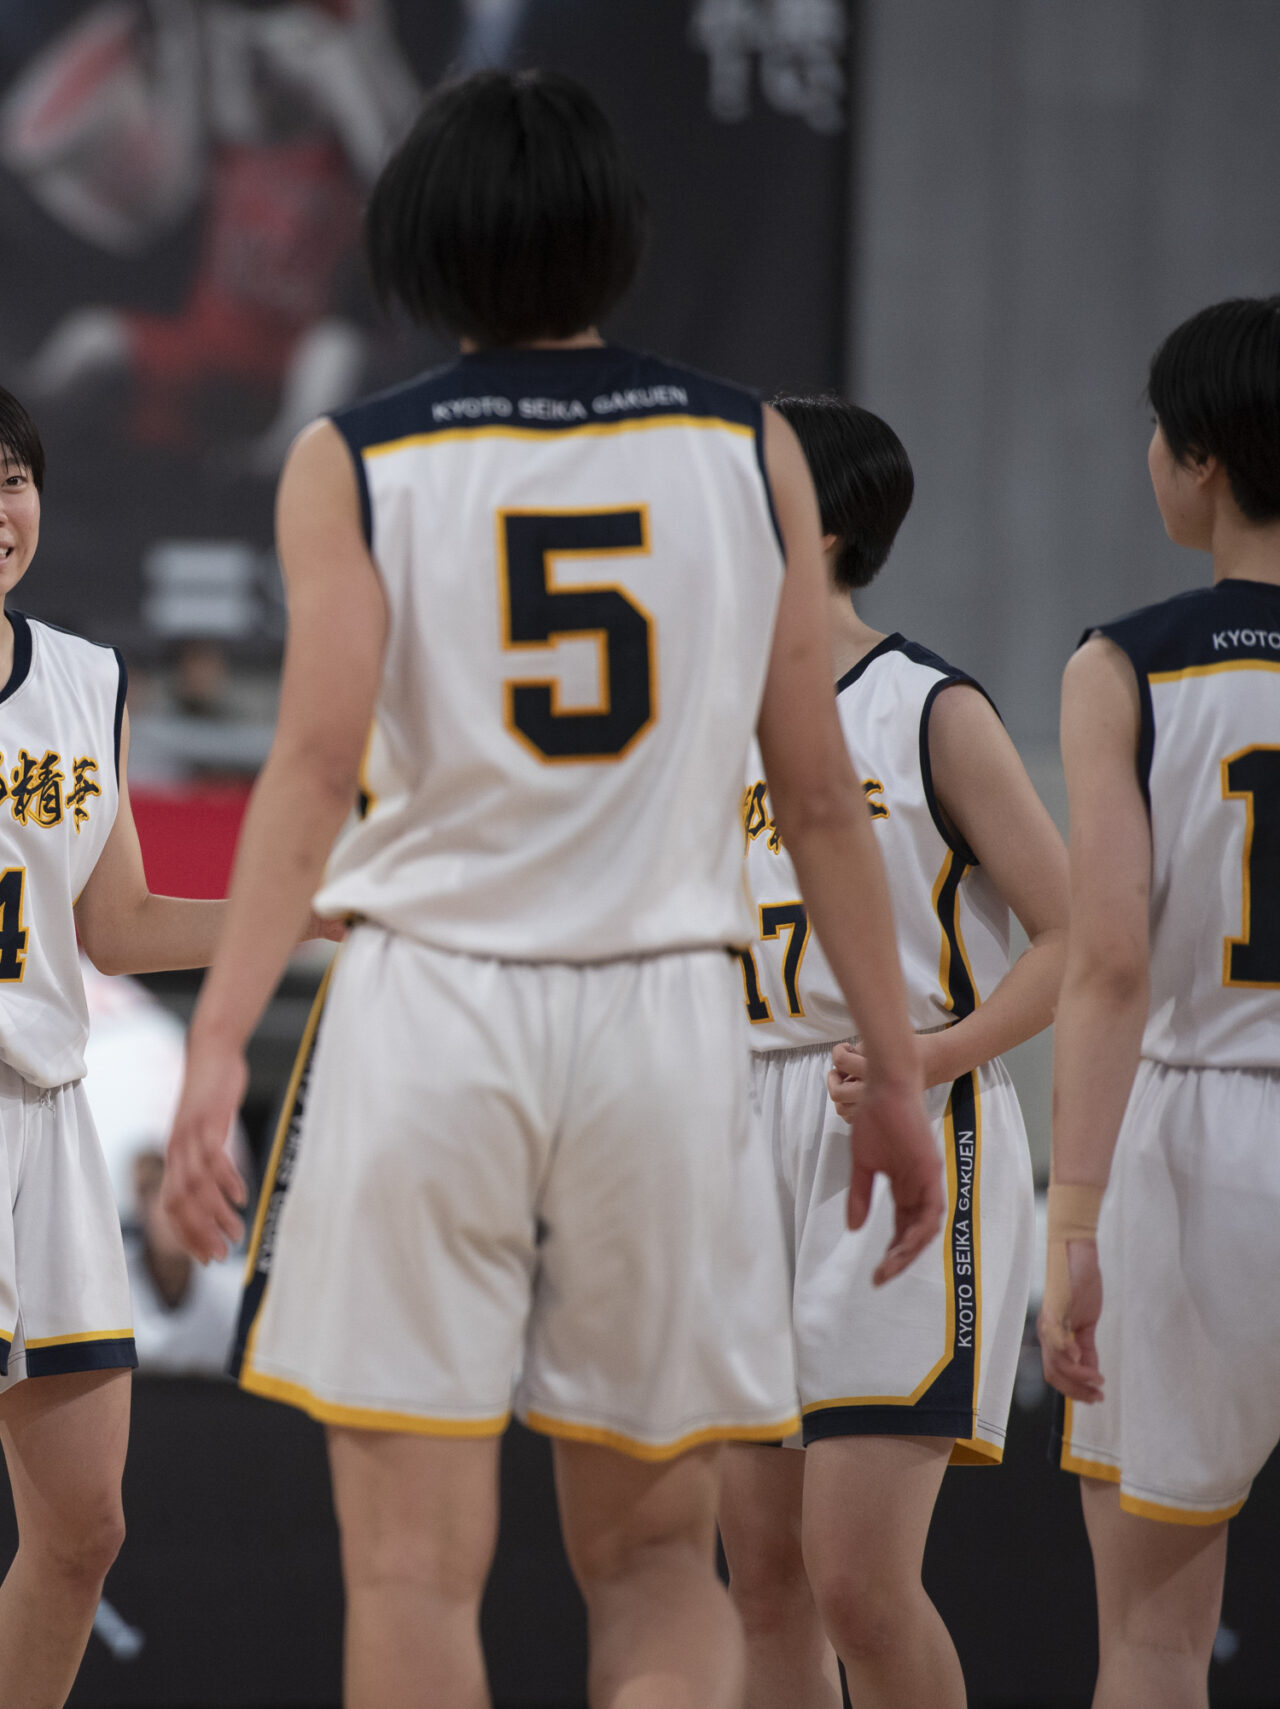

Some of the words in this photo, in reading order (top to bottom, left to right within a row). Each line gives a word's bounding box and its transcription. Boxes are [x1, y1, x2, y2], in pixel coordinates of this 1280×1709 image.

[431, 396, 513, 423] KYOTO
[517, 397, 588, 421] SEIKA
[591, 385, 688, 415] GAKUEN
[496, 504, 658, 766] 5
[738, 899, 811, 1024] 17
[958, 1130, 974, 1211] GAKUEN
[956, 1219, 971, 1276] SEIKA
[957, 1284, 973, 1348] KYOTO
